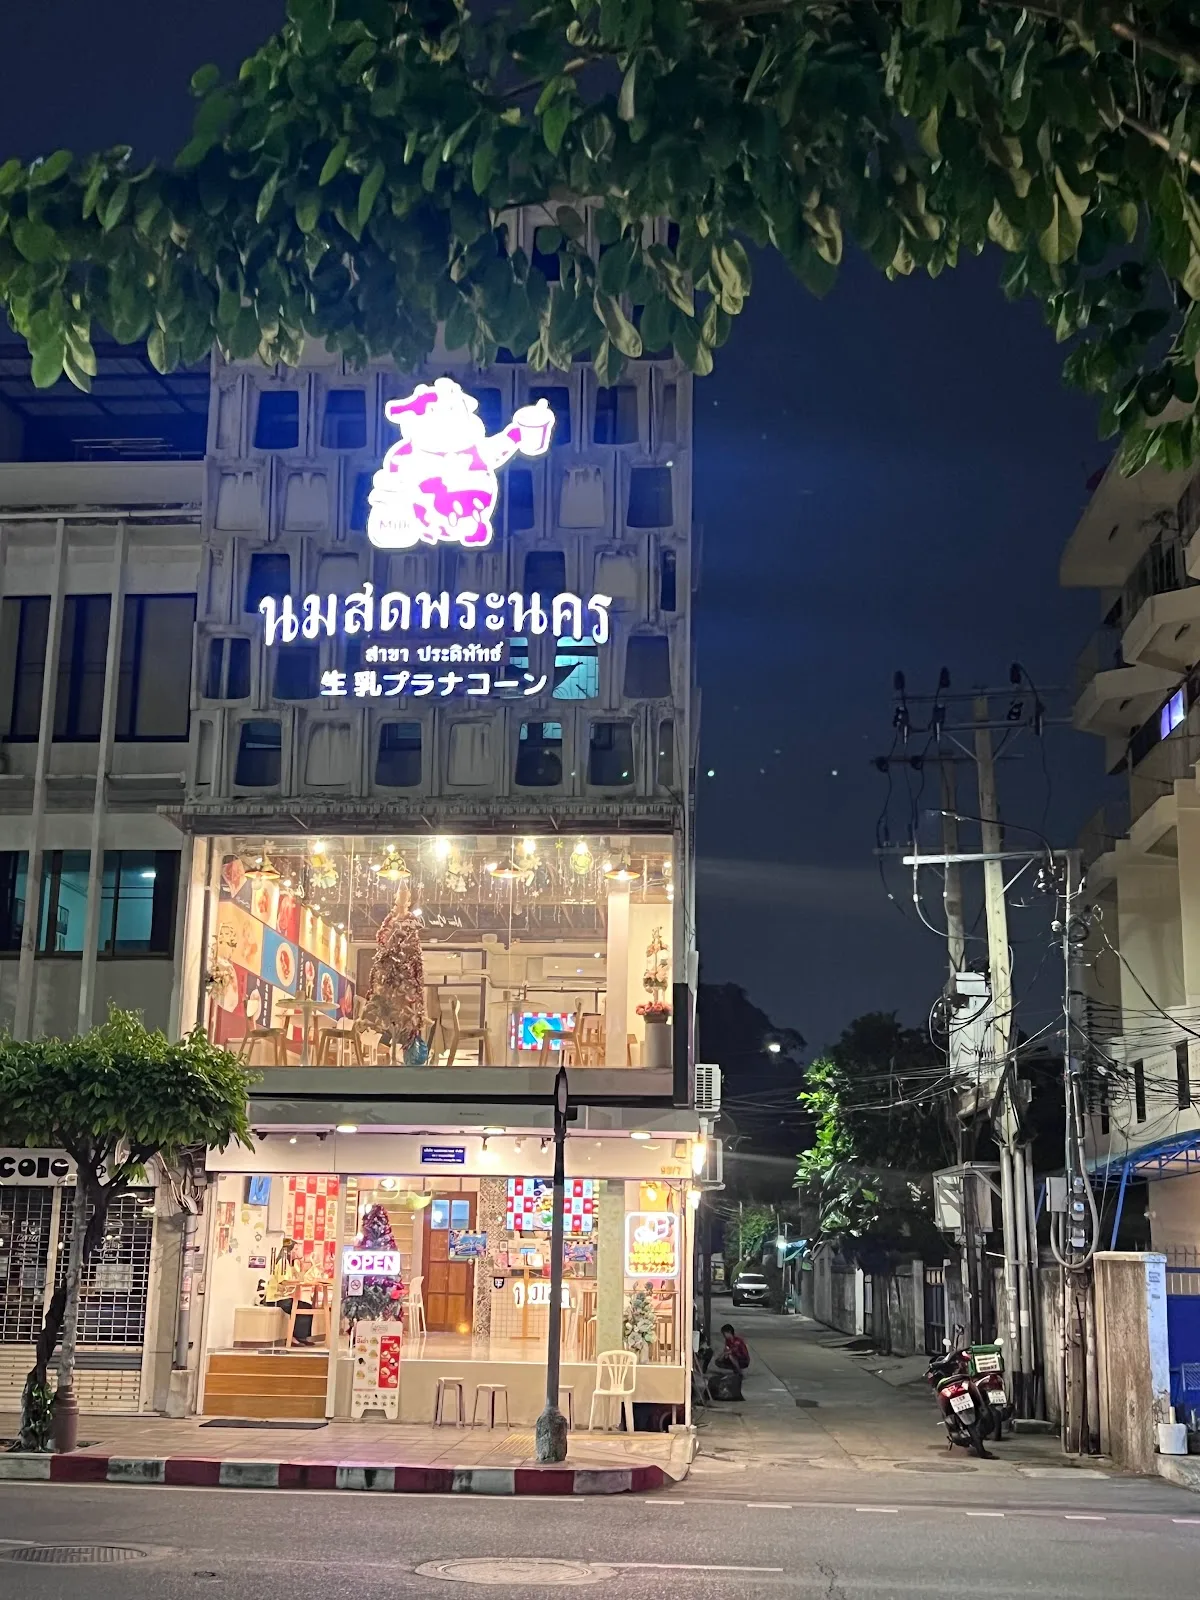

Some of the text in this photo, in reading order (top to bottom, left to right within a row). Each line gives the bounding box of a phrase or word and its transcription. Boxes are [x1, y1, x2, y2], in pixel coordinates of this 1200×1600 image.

[259, 582, 613, 646] นมสดพระนคร
[365, 645, 410, 662] สาขา
[320, 670, 548, 698] 生乳プラナコーン
[347, 1254, 396, 1271] OPEN
